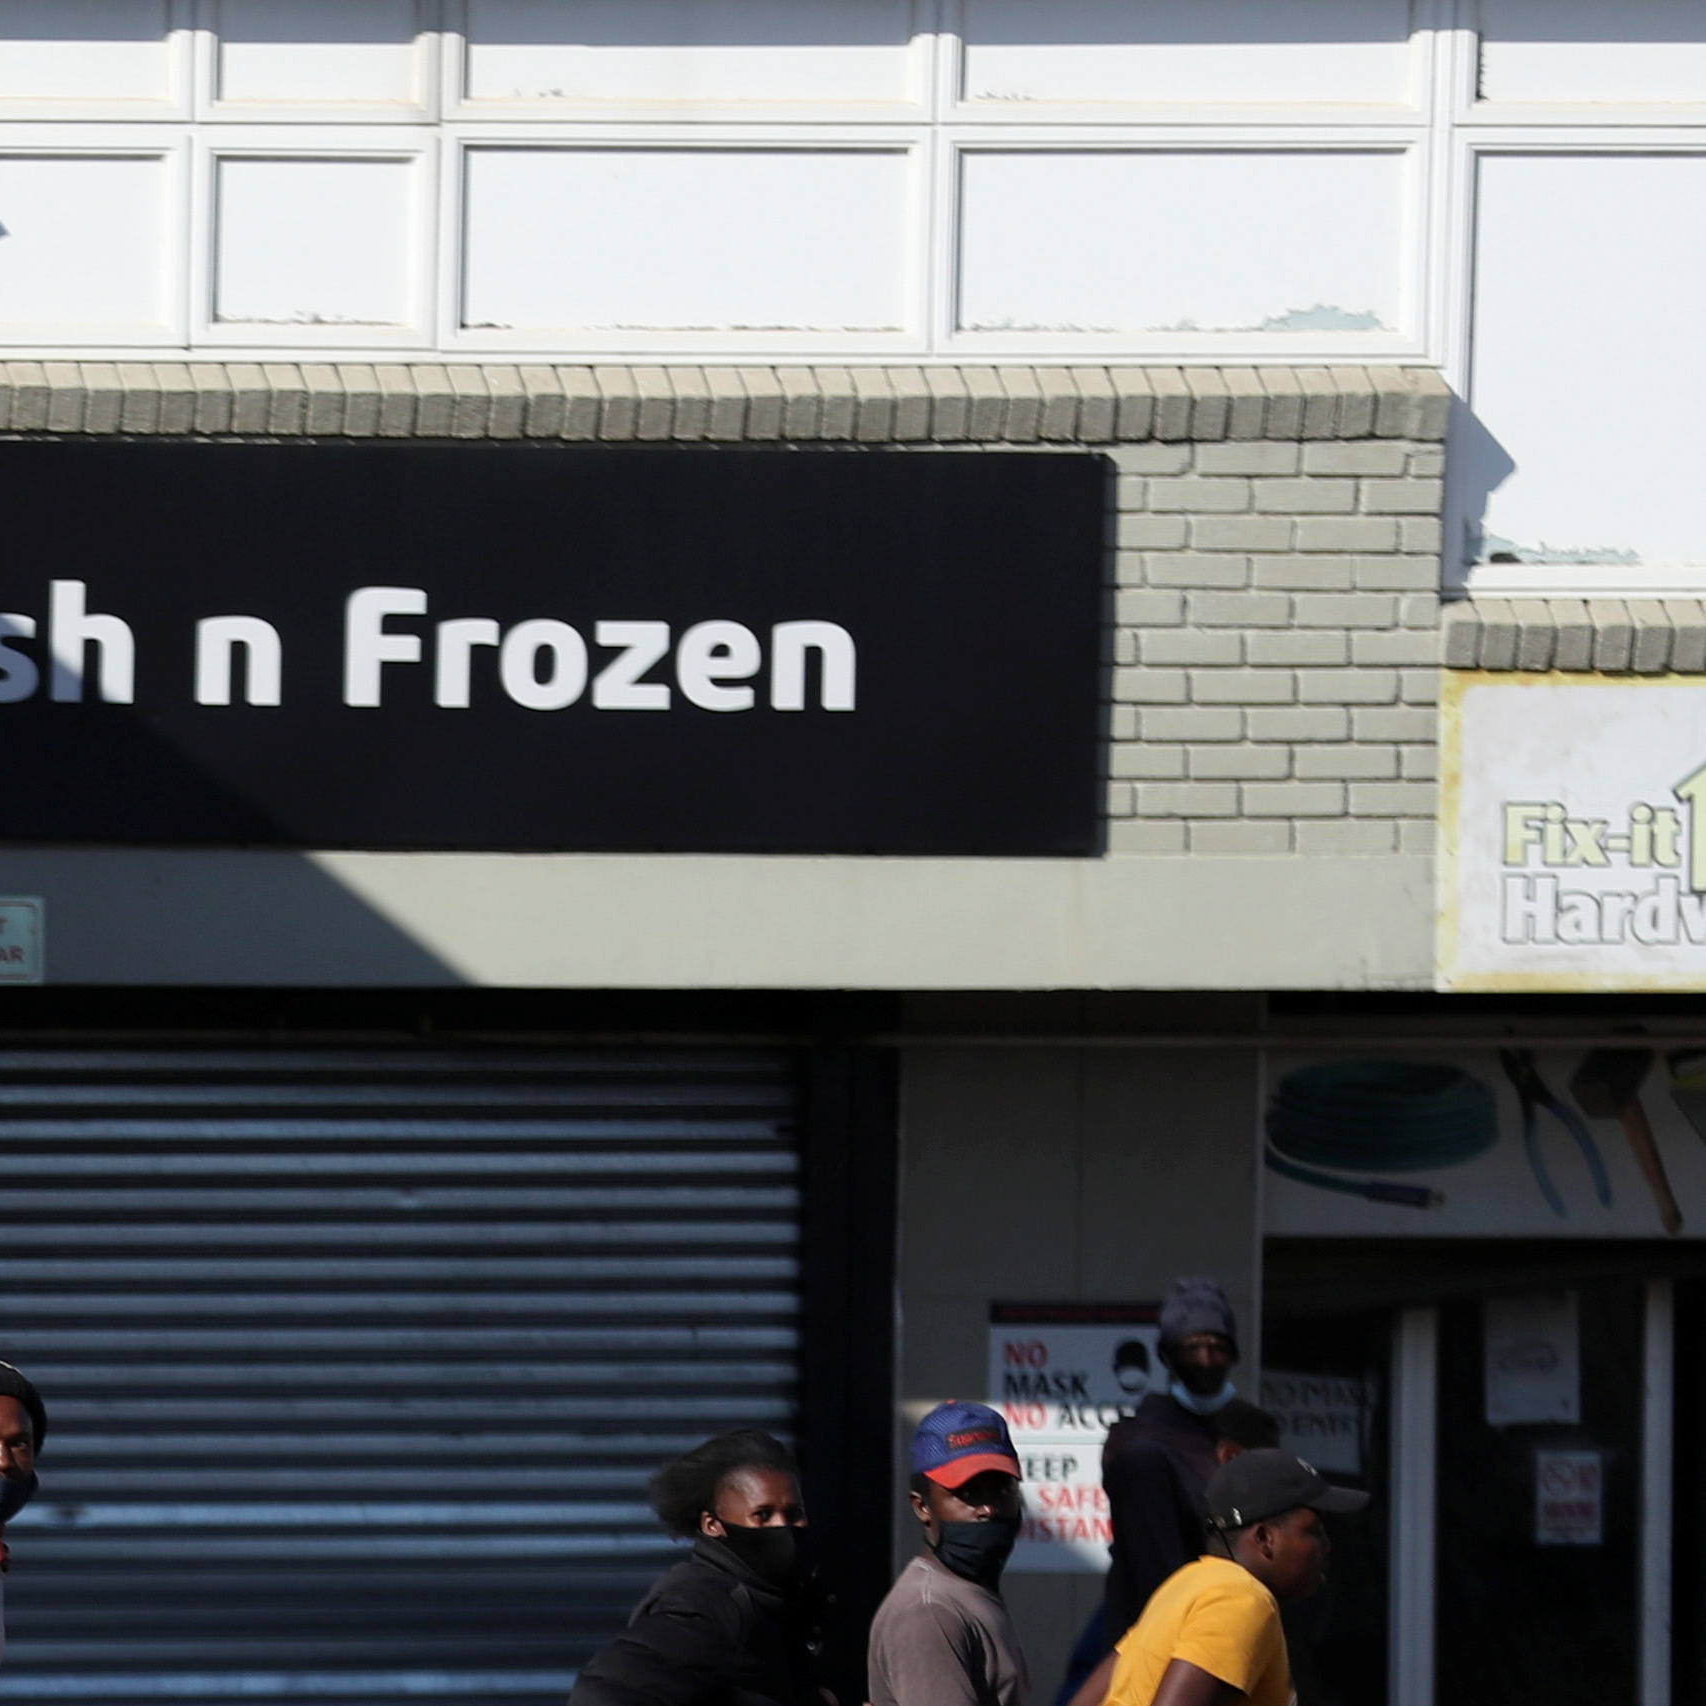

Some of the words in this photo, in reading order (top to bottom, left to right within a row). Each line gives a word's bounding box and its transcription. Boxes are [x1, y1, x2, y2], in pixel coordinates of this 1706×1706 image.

[194, 614, 282, 706] n
[342, 585, 857, 712] Frozen
[1501, 800, 1682, 869] Fix-it
[1003, 1340, 1049, 1369] NO
[1003, 1370, 1088, 1400] MASK
[1003, 1401, 1048, 1430] NO
[1022, 1454, 1078, 1482] EEP
[1037, 1483, 1109, 1513] SAFE
[1021, 1516, 1114, 1543] ISTAN
